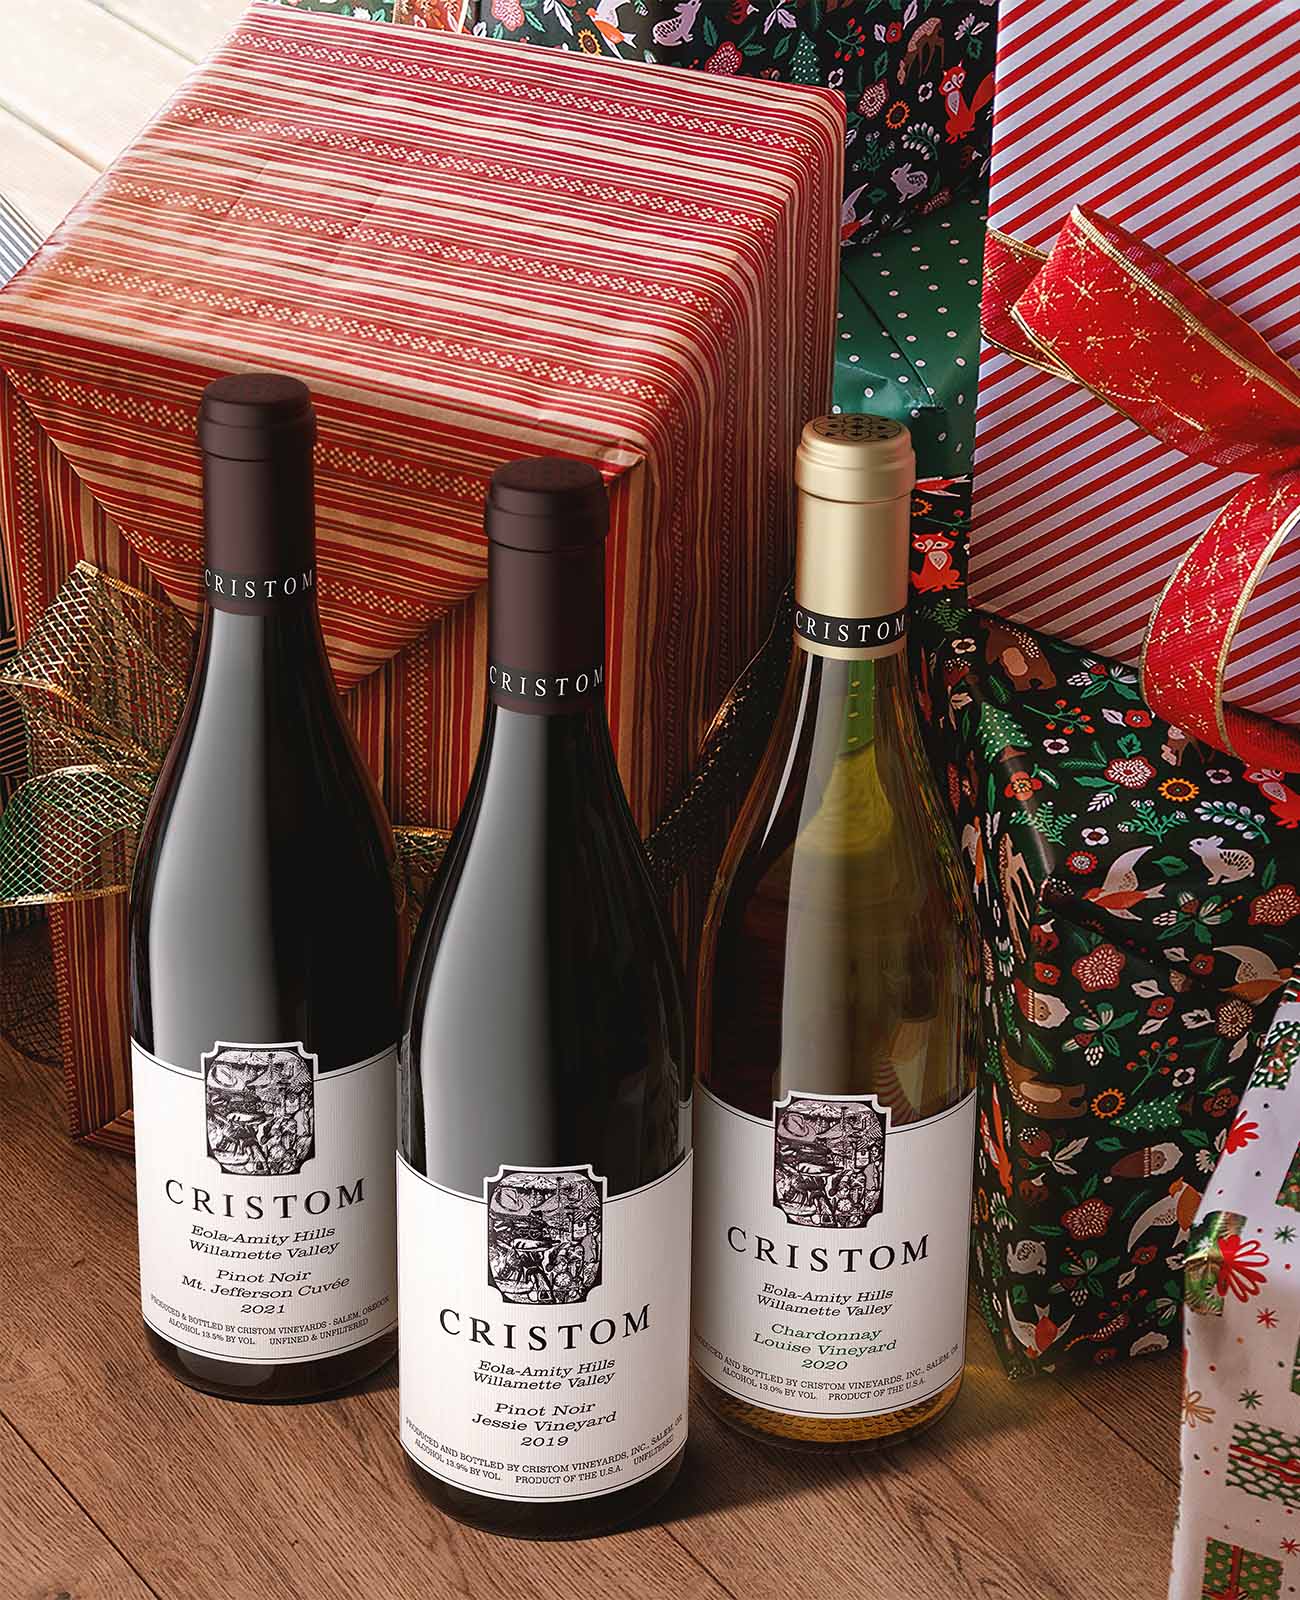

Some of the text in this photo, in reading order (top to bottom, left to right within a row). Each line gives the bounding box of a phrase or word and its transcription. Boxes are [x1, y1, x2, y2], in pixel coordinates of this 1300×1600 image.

[204, 568, 314, 599] CRISTOM
[794, 610, 905, 642] CRISTOM
[489, 664, 603, 697] CRISTOM
[165, 1178, 366, 1220] CRISTOM
[191, 1224, 336, 1246] Eola-Amity Hills
[189, 1239, 340, 1260] Willamette Valley
[727, 1226, 929, 1273] CRISTOM
[181, 1275, 350, 1299] Mt. Jefferson Cuvée
[216, 1268, 312, 1283] Pinot Noir
[762, 1282, 894, 1305] Eola-Amity Hills
[240, 1303, 286, 1314] 2021
[757, 1294, 893, 1317] Willamette Valley
[168, 1317, 200, 1336] ALCOHOL
[202, 1331, 225, 1342] 13.5%
[225, 1335, 237, 1344] BY
[269, 1334, 309, 1346] UNFINED
[311, 1333, 319, 1342] &
[319, 1317, 369, 1340] UNFILTERED
[188, 1314, 223, 1331] BOTTLED
[225, 1324, 236, 1333] BY
[237, 1326, 277, 1335] CRISTOM
[279, 1320, 327, 1334] VINEYARDS
[440, 1304, 651, 1351] CRISTOM
[771, 1323, 882, 1341] Chardonnay
[753, 1332, 897, 1358] Louise Vineyard
[478, 1359, 616, 1379] Eola-Amity Hills
[724, 1356, 740, 1370] AND
[742, 1365, 784, 1384] BOTTLED
[786, 1377, 798, 1388] BY
[800, 1379, 845, 1391] CRISTOM
[801, 1359, 848, 1371] 2020
[473, 1371, 616, 1391] Willamette Valley
[722, 1366, 758, 1388] ALCOHOL
[759, 1383, 783, 1395] 13.0%
[785, 1388, 797, 1398] BY
[828, 1391, 871, 1401] PRODUCT
[873, 1390, 885, 1399] OF
[887, 1384, 904, 1396] THE
[495, 1402, 596, 1417] Pinot Noir
[472, 1411, 617, 1433] Jessie Vineyard
[520, 1435, 568, 1447] 2019
[440, 1444, 458, 1458] AND
[460, 1452, 504, 1470] BOTTLED
[506, 1463, 520, 1472] BY
[522, 1464, 569, 1473] CRISTOM
[572, 1451, 629, 1471] VINEYARDS,
[446, 1458, 468, 1473] 13.9%
[469, 1466, 481, 1476] BY
[515, 1475, 561, 1485] PRODUCT
[563, 1474, 577, 1483] OF
[578, 1470, 598, 1481] THE
[599, 1464, 623, 1477] U.S.A.
